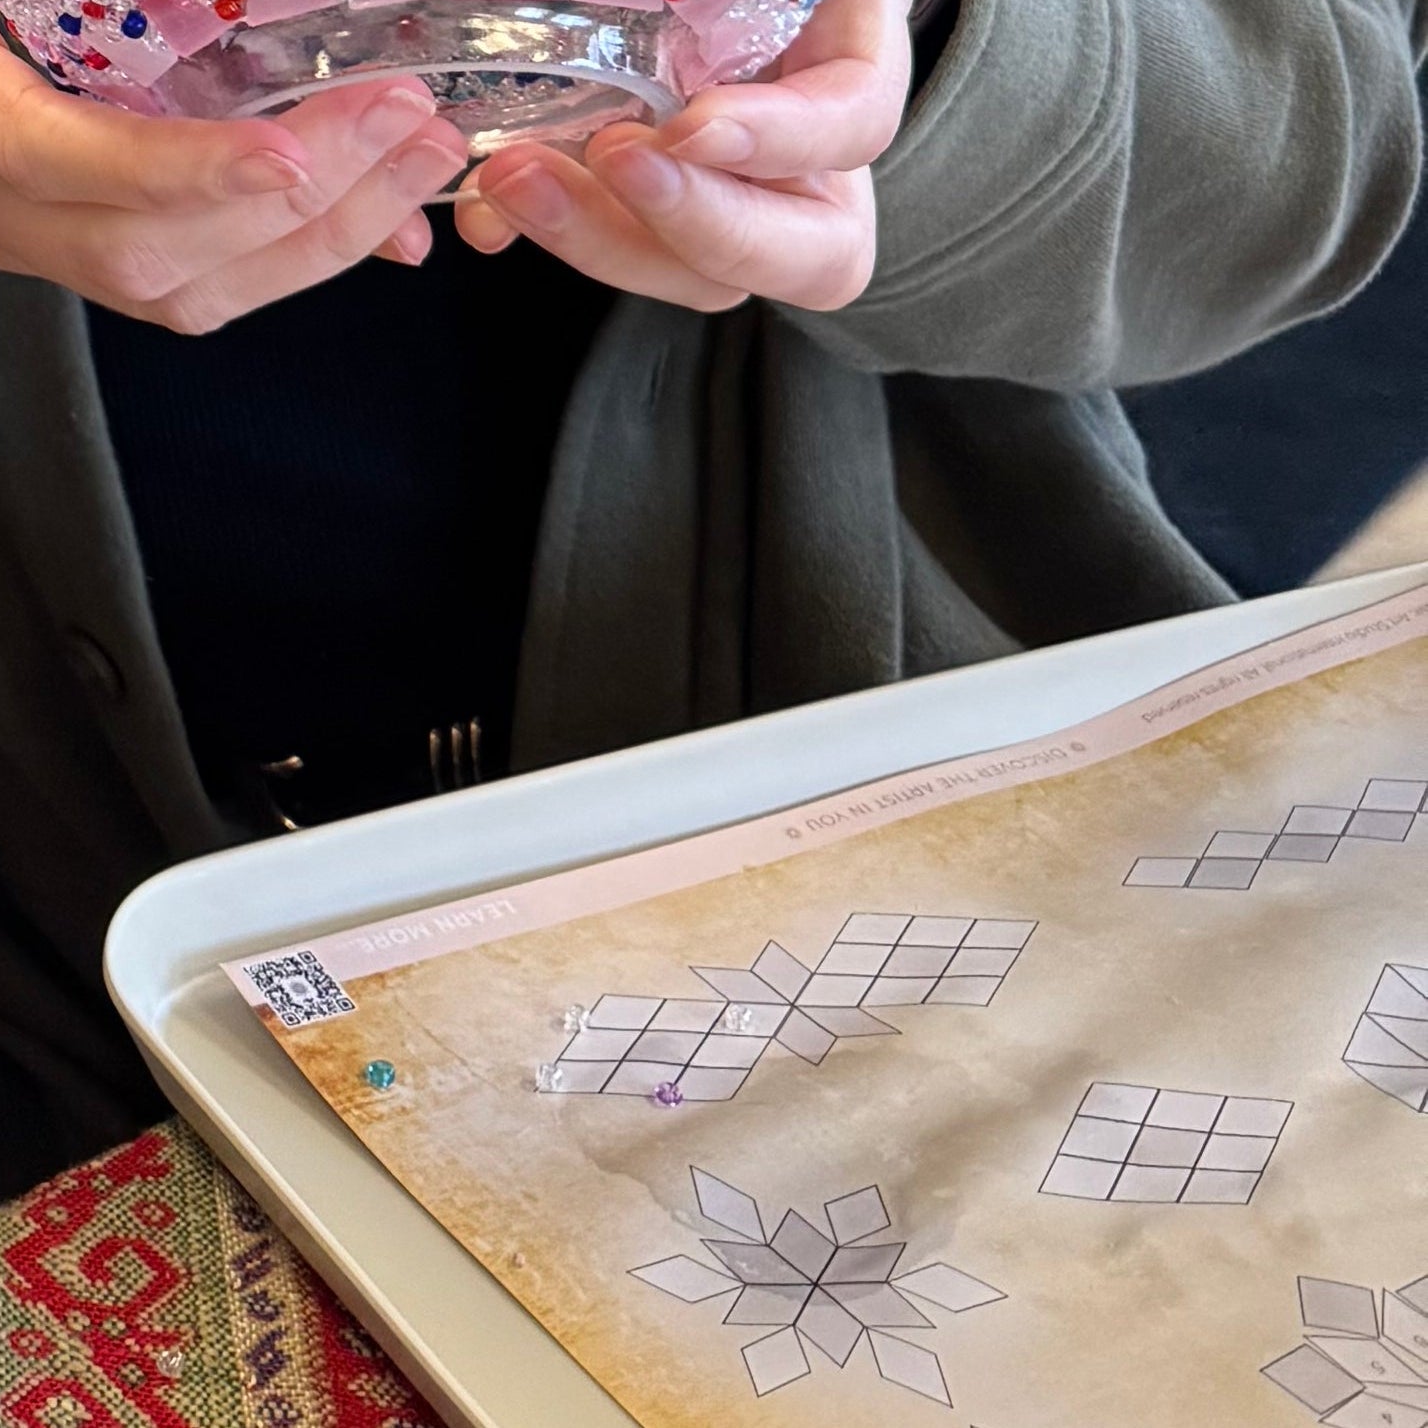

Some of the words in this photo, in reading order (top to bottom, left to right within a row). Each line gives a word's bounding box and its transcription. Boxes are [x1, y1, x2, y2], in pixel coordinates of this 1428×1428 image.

[978, 747, 1068, 778] DISCOVER
[936, 772, 978, 789] THE
[874, 781, 934, 809] ARTIST
[848, 802, 873, 816] IN
[805, 812, 850, 831] YOU
[434, 899, 518, 932] LEARN
